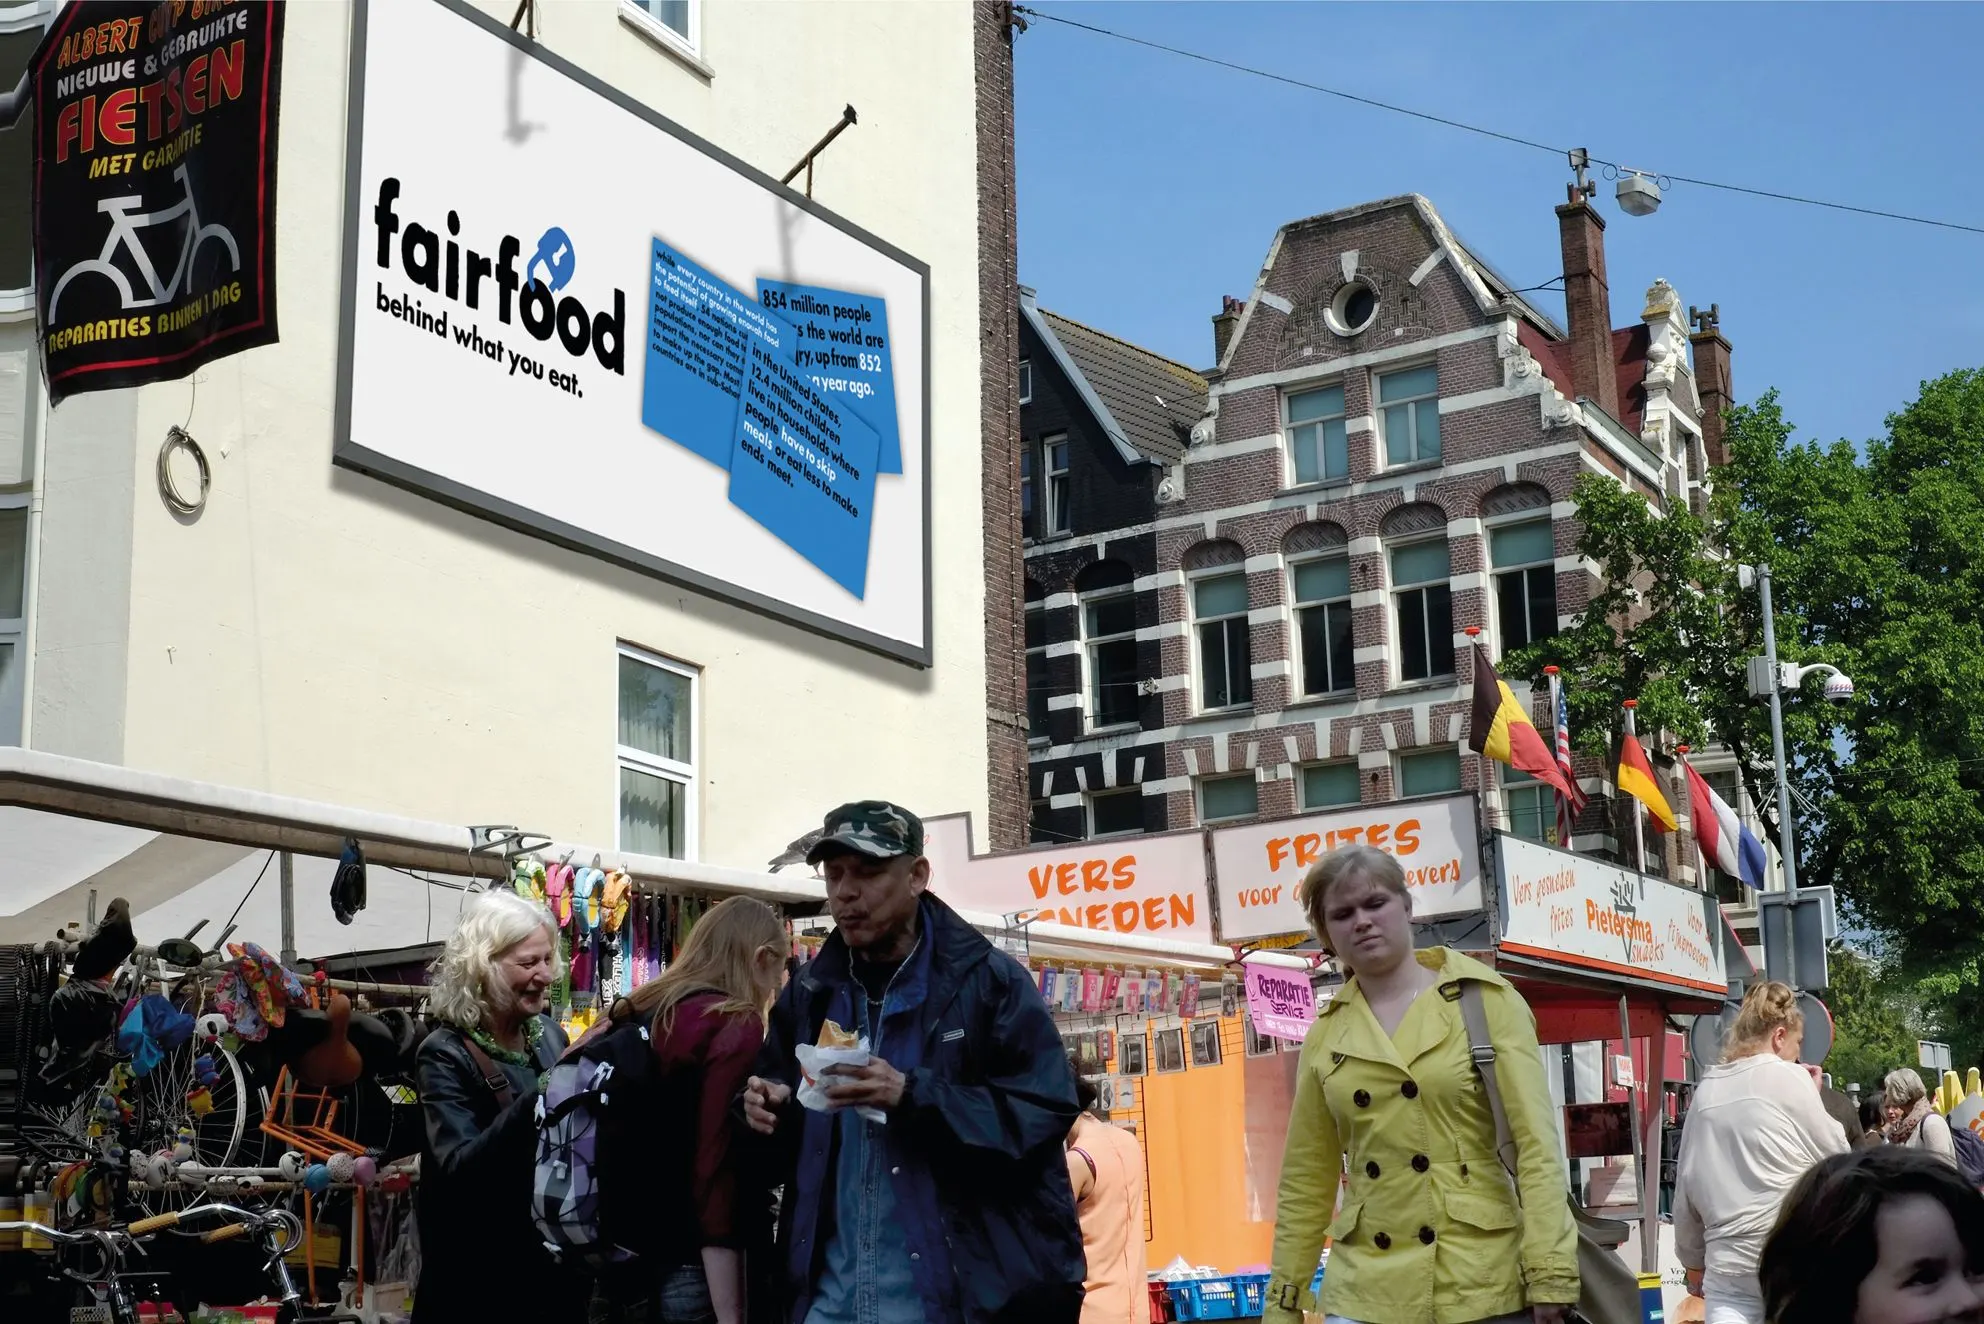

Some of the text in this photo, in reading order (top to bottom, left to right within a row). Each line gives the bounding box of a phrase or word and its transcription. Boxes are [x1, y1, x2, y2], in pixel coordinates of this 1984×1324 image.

[56, 59, 136, 99] NIEUWE
[143, 54, 158, 76] &
[160, 9, 248, 66] GEBRUIKTE
[57, 16, 144, 70] ALBERT
[56, 40, 246, 164] FIETSEN
[88, 123, 203, 180] MET GARANTIE
[374, 177, 625, 376] fairfood
[656, 250, 778, 334] while every country in the world has
[48, 316, 152, 354] REPARATIES
[158, 300, 202, 334] BINNEN
[212, 282, 242, 313] DAG
[654, 276, 662, 286] to
[664, 280, 679, 297] feed
[712, 312, 737, 334] nations
[656, 262, 780, 348] the potential of growing enough food
[656, 290, 668, 303] not
[668, 298, 696, 320] produce
[698, 314, 723, 340] enough
[724, 329, 740, 349] food
[763, 290, 872, 325] 854 million people
[376, 281, 584, 398] behind what you eat.
[653, 328, 660, 338] to
[662, 336, 682, 352] make
[684, 348, 693, 360] up
[694, 353, 705, 366] the
[724, 370, 740, 387] Most
[654, 316, 678, 337] import
[679, 330, 690, 344] the
[692, 340, 725, 366] necessary
[698, 330, 710, 343] nor
[712, 339, 724, 352] can
[725, 346, 740, 362] they
[806, 320, 826, 340] the
[829, 327, 862, 348] world
[865, 334, 884, 349] are
[815, 352, 830, 369] up
[830, 348, 859, 369] from
[860, 353, 882, 372] 852
[652, 343, 684, 367] countries
[685, 362, 696, 374] are
[698, 368, 705, 379] in
[752, 342, 842, 428] in the United States,
[751, 362, 841, 446] 12.4 million children
[820, 376, 848, 392] year
[850, 379, 874, 399] ago.
[745, 402, 836, 482] people have to skip
[748, 380, 860, 481] live in households where
[741, 439, 794, 488] ends meet.
[744, 420, 859, 518] meals or eat less to make
[1028, 855, 1137, 900] VERS
[1238, 884, 1283, 908] voor
[1407, 859, 1461, 888] evers
[1512, 863, 1576, 908] Vers gesneden
[1018, 893, 1196, 934] NEDEN
[1550, 904, 1574, 940] frites
[1586, 899, 1653, 944] Pietersma
[1687, 902, 1703, 935] Voor
[1257, 973, 1311, 1007] REPARATIE
[1270, 1000, 1304, 1019] SERVICE
